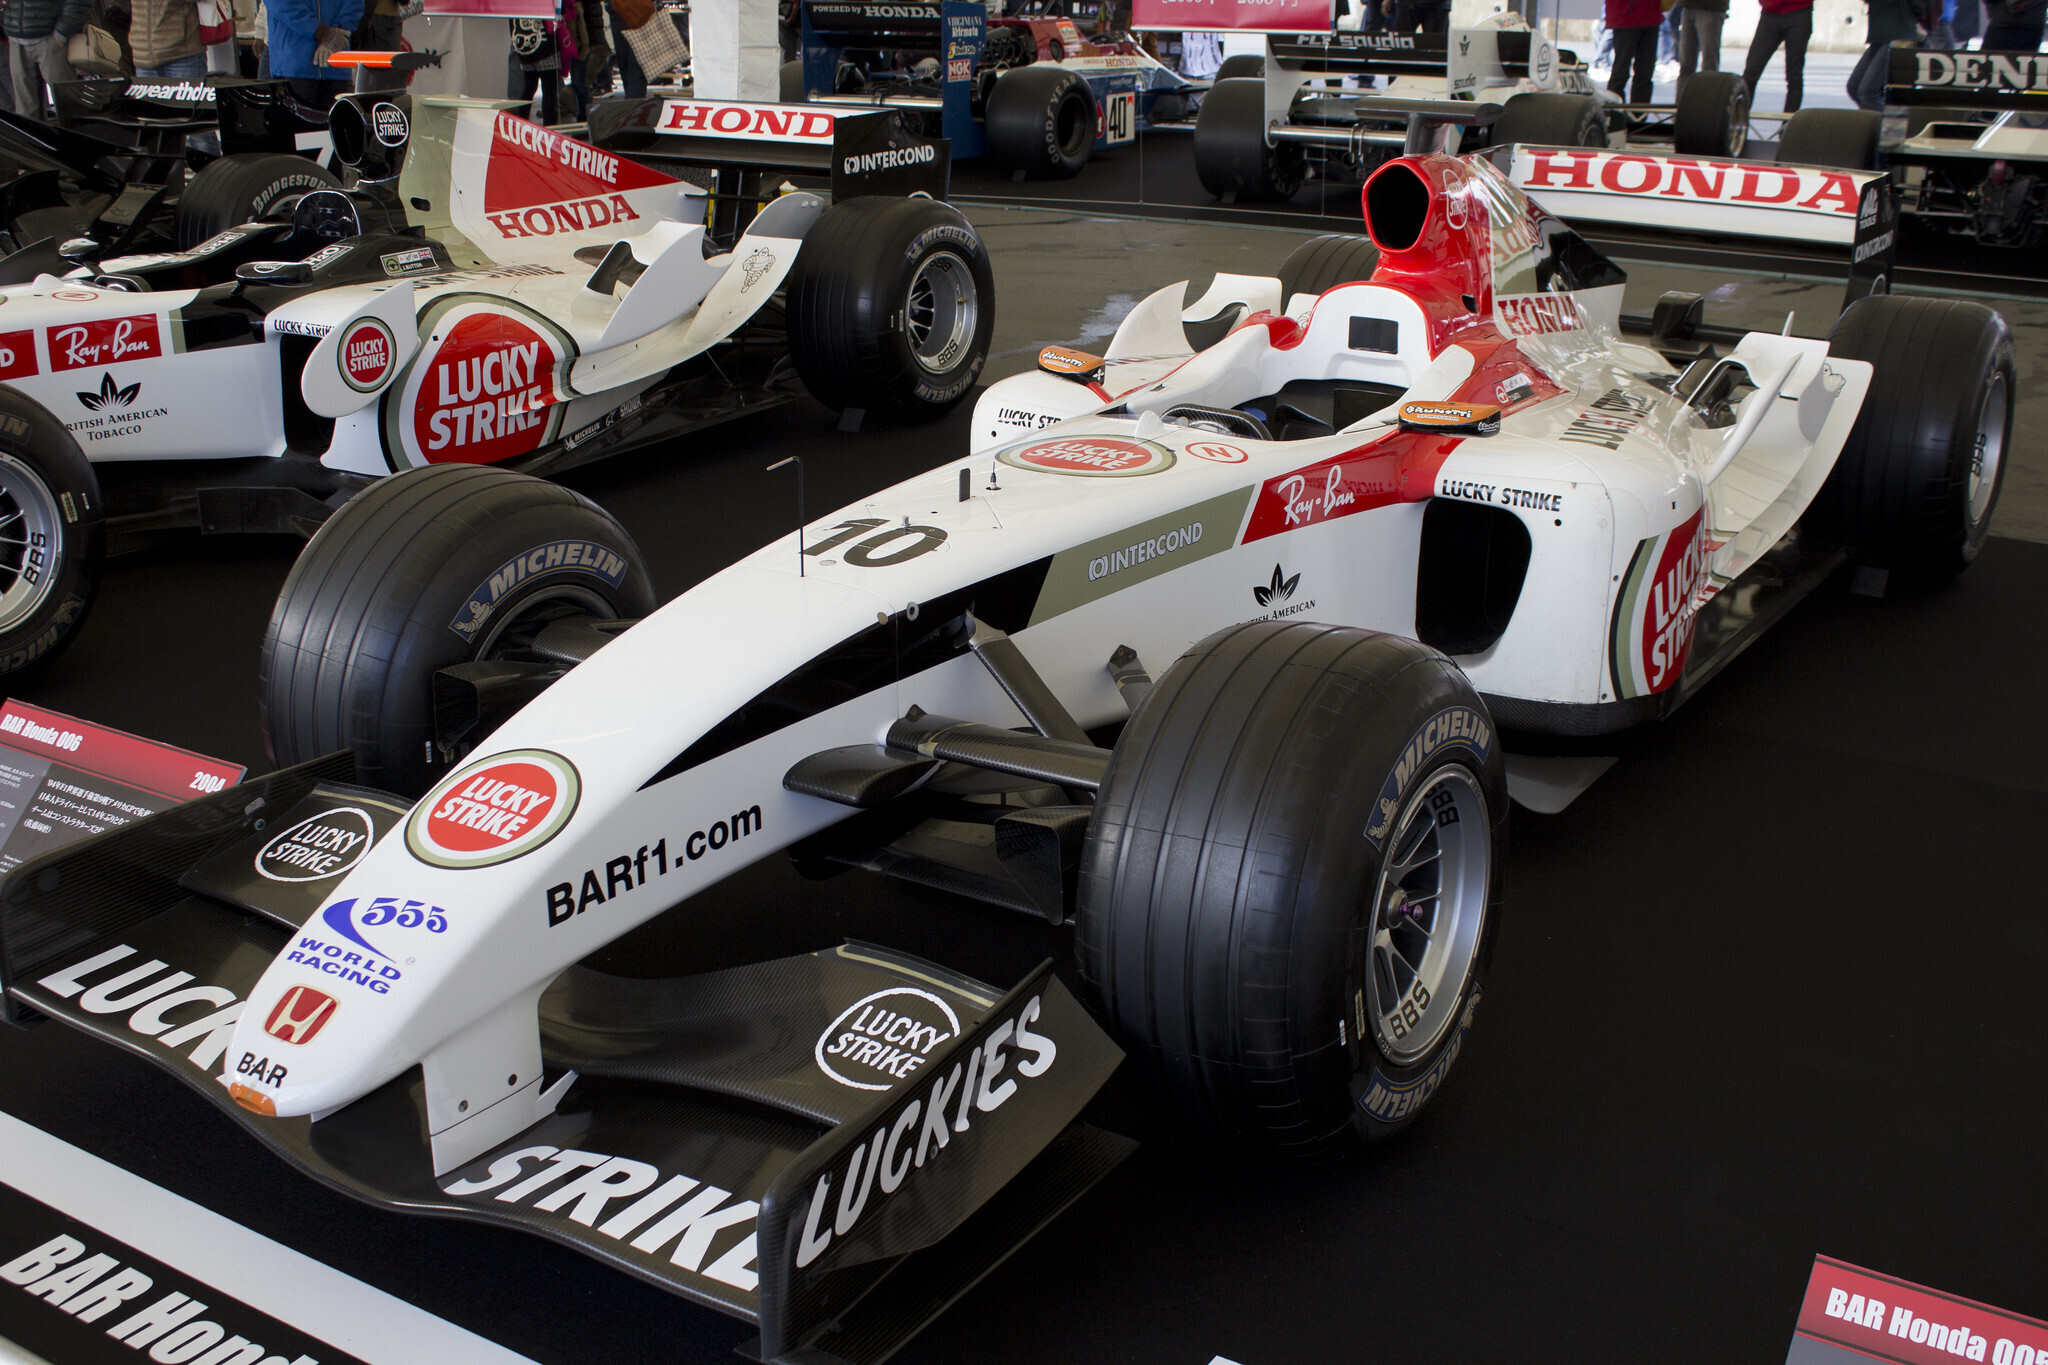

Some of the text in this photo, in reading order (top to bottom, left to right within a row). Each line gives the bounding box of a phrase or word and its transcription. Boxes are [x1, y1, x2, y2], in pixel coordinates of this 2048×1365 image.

[813, 5, 942, 18] POWERED by HONDA
[948, 61, 971, 76] NGK
[1105, 58, 1137, 67] HONDA
[375, 110, 402, 124] LUCKY
[378, 120, 406, 138] STRIKE
[1109, 96, 1127, 140] 40
[499, 115, 619, 184] LUCKY STRIKE
[861, 145, 935, 171] INTERCOND
[1523, 149, 1860, 213] HONDA
[486, 194, 640, 239] HONDA
[922, 226, 977, 251] MICHELIN
[274, 319, 302, 334] LUCKY
[1498, 295, 1585, 337] HONDA
[350, 353, 387, 373] STRIKE
[351, 338, 384, 358] LUCKY
[937, 339, 959, 366] BBS
[438, 341, 539, 407] LUCKY
[917, 373, 973, 401] MICHELIN
[87, 424, 142, 441] TOBACCO
[108, 407, 168, 426] AMERICAN
[428, 385, 545, 451] STRIKE
[575, 422, 600, 442] MICHELIN
[997, 408, 1036, 429] LUCKY
[1027, 448, 1129, 470] STRIKE
[1049, 442, 1146, 461] LUCKY
[1203, 447, 1234, 457] N
[1442, 479, 1562, 512] LUCKY STRIKE
[24, 532, 46, 587] BBS
[798, 518, 948, 567] 10
[1110, 522, 1203, 574] INTERCOND
[489, 543, 625, 602] MICHELIN
[1655, 519, 1705, 633] LUCKY
[1271, 599, 1316, 621] AMERICAN
[0, 713, 84, 752] BAR Honda 006
[1395, 709, 1490, 791] MICHELIN
[189, 770, 227, 794] 2004
[463, 776, 552, 815] LUCKY
[292, 823, 366, 854] LUCKY
[434, 797, 529, 841] STRIKE
[266, 842, 342, 874] STRIKE
[546, 804, 763, 929] BARf1.com
[361, 897, 448, 934] 555
[287, 950, 391, 994] RACING
[299, 937, 401, 981] WORLD
[36, 943, 248, 1087] LUCK
[1390, 980, 1431, 1040] BBS
[850, 1005, 952, 1055] LUCKY
[826, 1032, 925, 1081] STRIKE
[1364, 1036, 1462, 1118] MICHELIN
[796, 995, 1057, 1268] LUCKIES
[0, 1233, 319, 1365] BAR Hon
[1824, 1287, 1886, 1331] BAR
[1888, 1306, 1987, 1362] Honda
